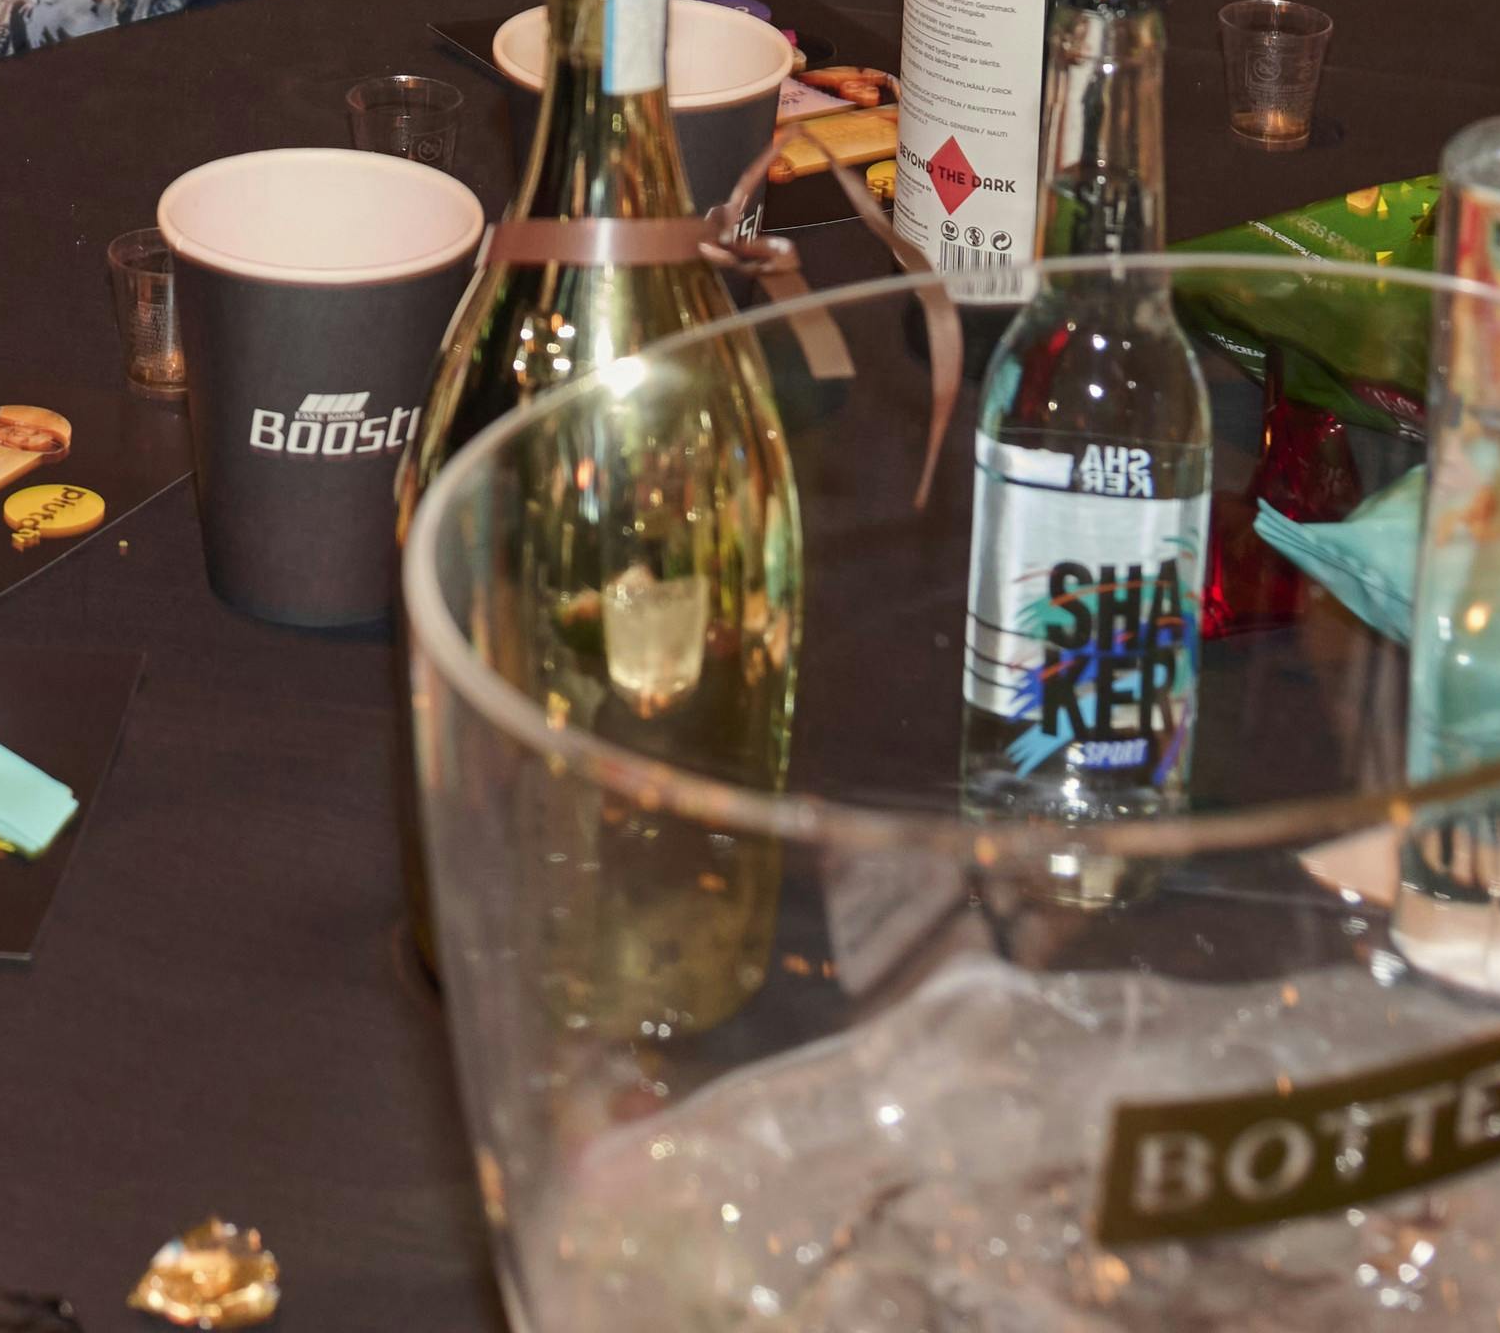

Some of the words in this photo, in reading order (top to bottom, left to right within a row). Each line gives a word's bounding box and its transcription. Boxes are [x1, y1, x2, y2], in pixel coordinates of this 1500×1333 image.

[966, 103, 1017, 117] RAVISTETTAVA
[899, 141, 934, 174] BEYOND
[937, 165, 967, 185] THE
[971, 174, 1017, 194] DARK
[1046, 558, 1186, 650] SHA
[1042, 642, 1180, 738] KER
[1080, 738, 1149, 765] SPORT
